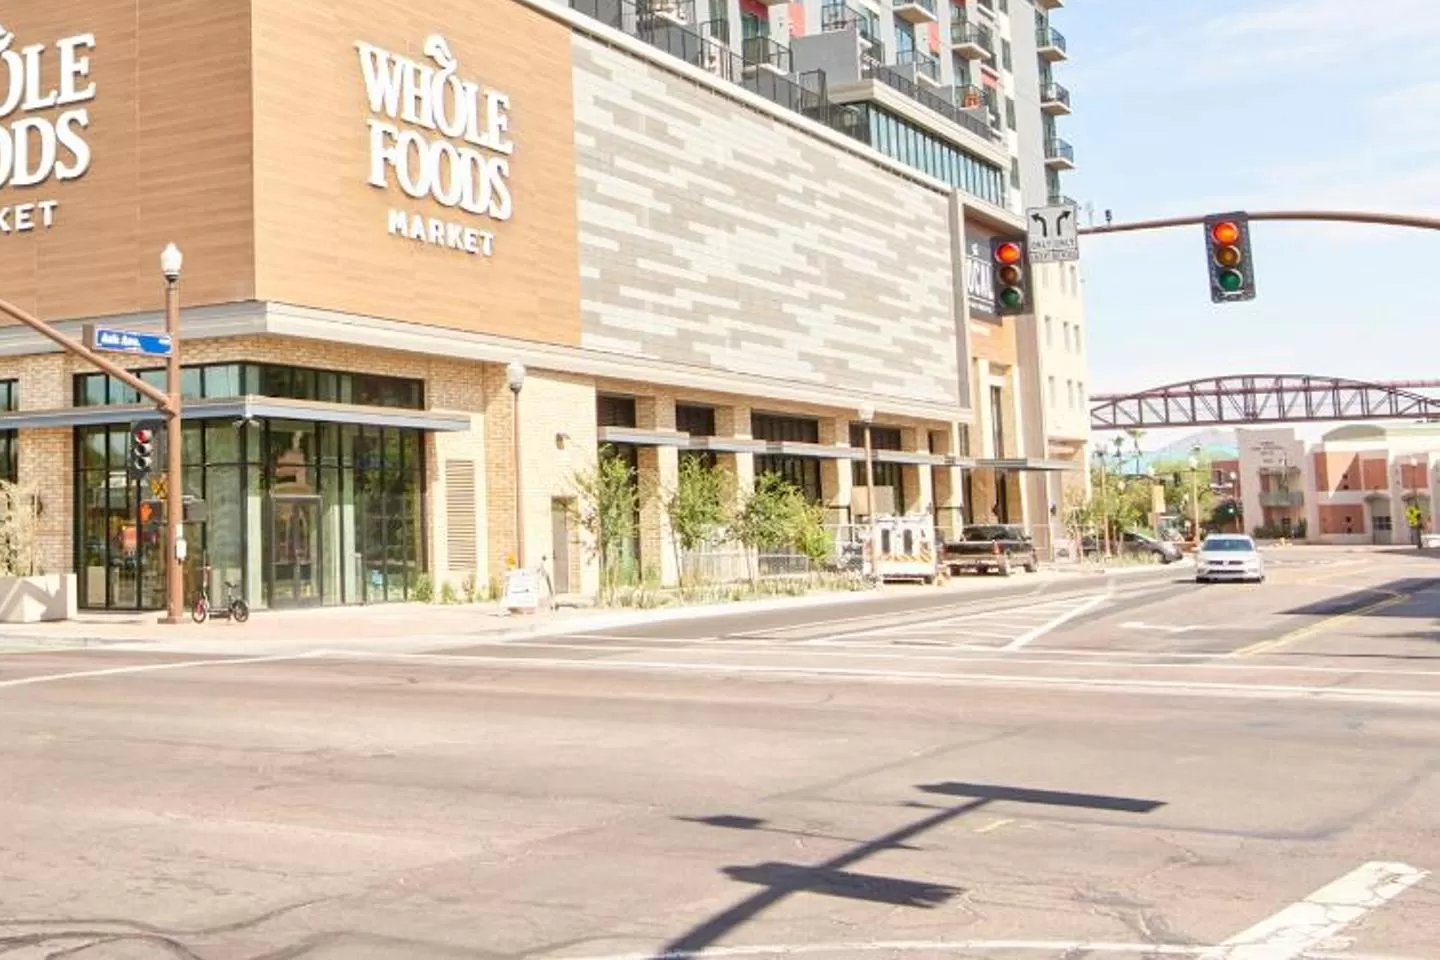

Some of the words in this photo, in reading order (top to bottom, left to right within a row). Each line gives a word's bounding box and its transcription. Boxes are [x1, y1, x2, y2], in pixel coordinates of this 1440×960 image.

[353, 35, 514, 156] WHOLE
[367, 117, 513, 221] FOODS
[387, 208, 497, 257] MARKET
